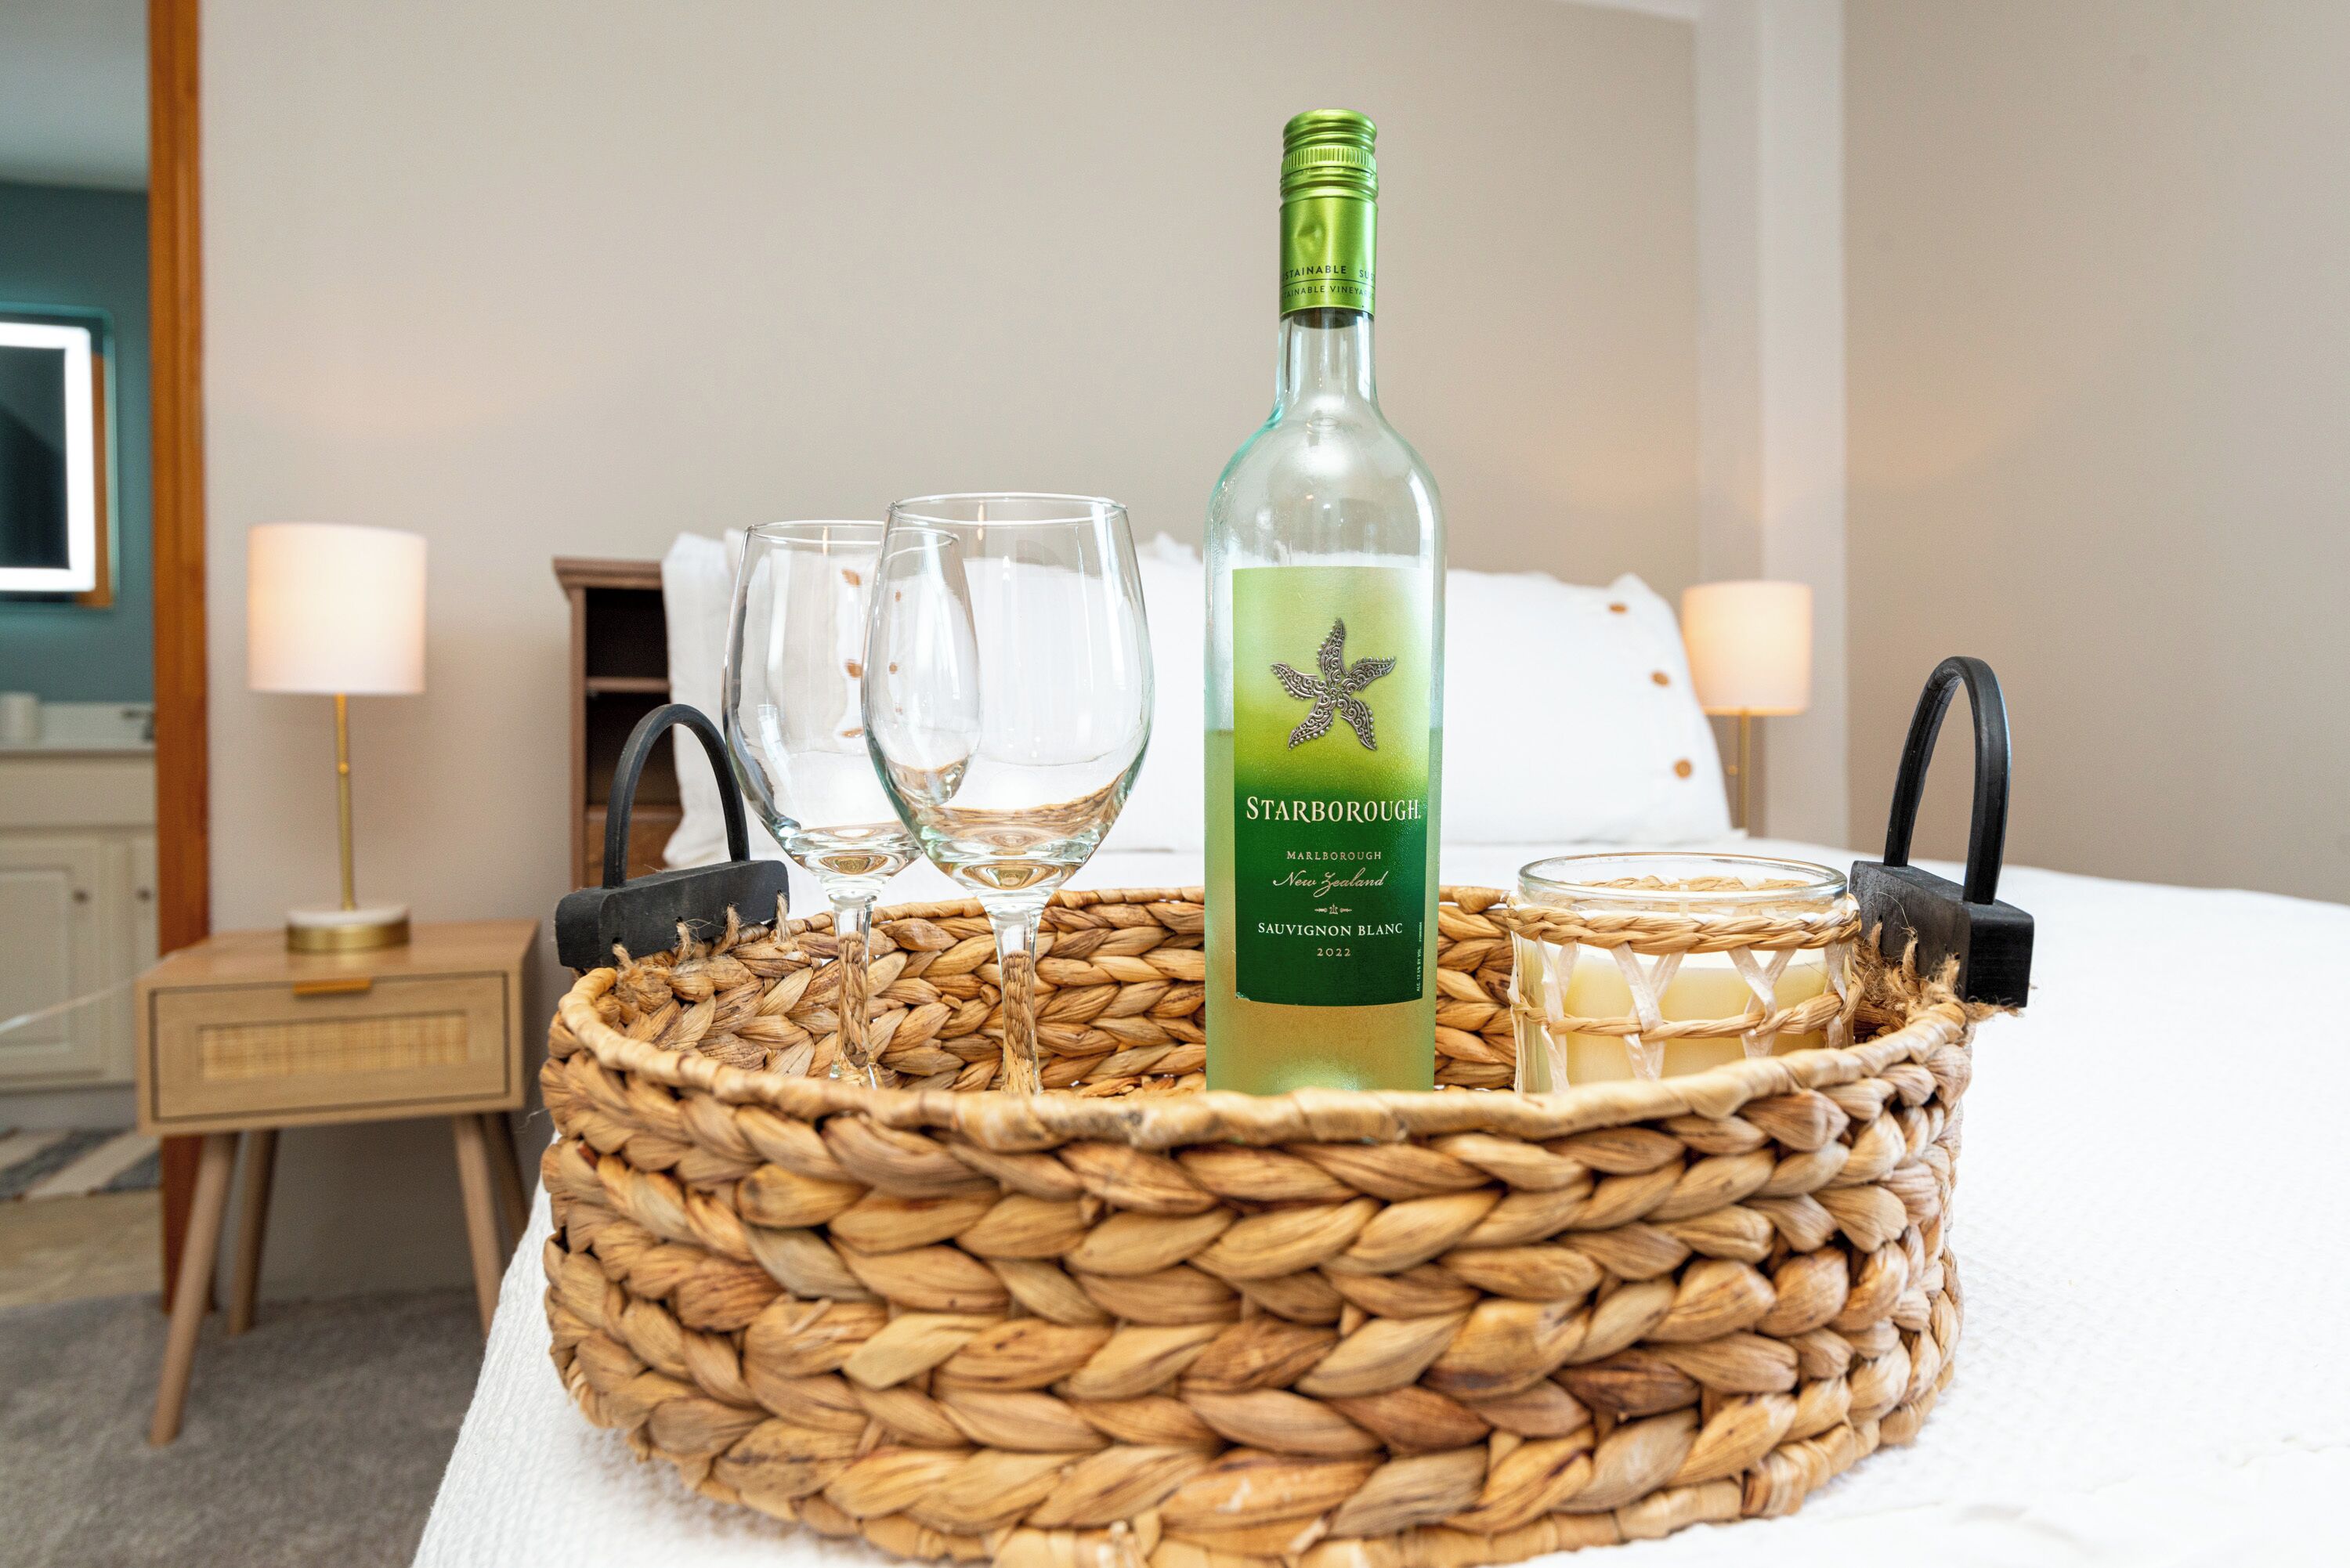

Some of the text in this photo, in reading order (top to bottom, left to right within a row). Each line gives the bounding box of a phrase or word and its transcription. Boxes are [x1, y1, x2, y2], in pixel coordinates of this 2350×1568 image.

[1246, 796, 1419, 824] STARBOROUGH
[1286, 851, 1382, 861] MARLBOROUGH
[1272, 867, 1389, 898] New Zealand
[1258, 923, 1351, 937] SAUVIGNON
[1358, 923, 1403, 937] BLANC
[1316, 947, 1351, 957] 2022
